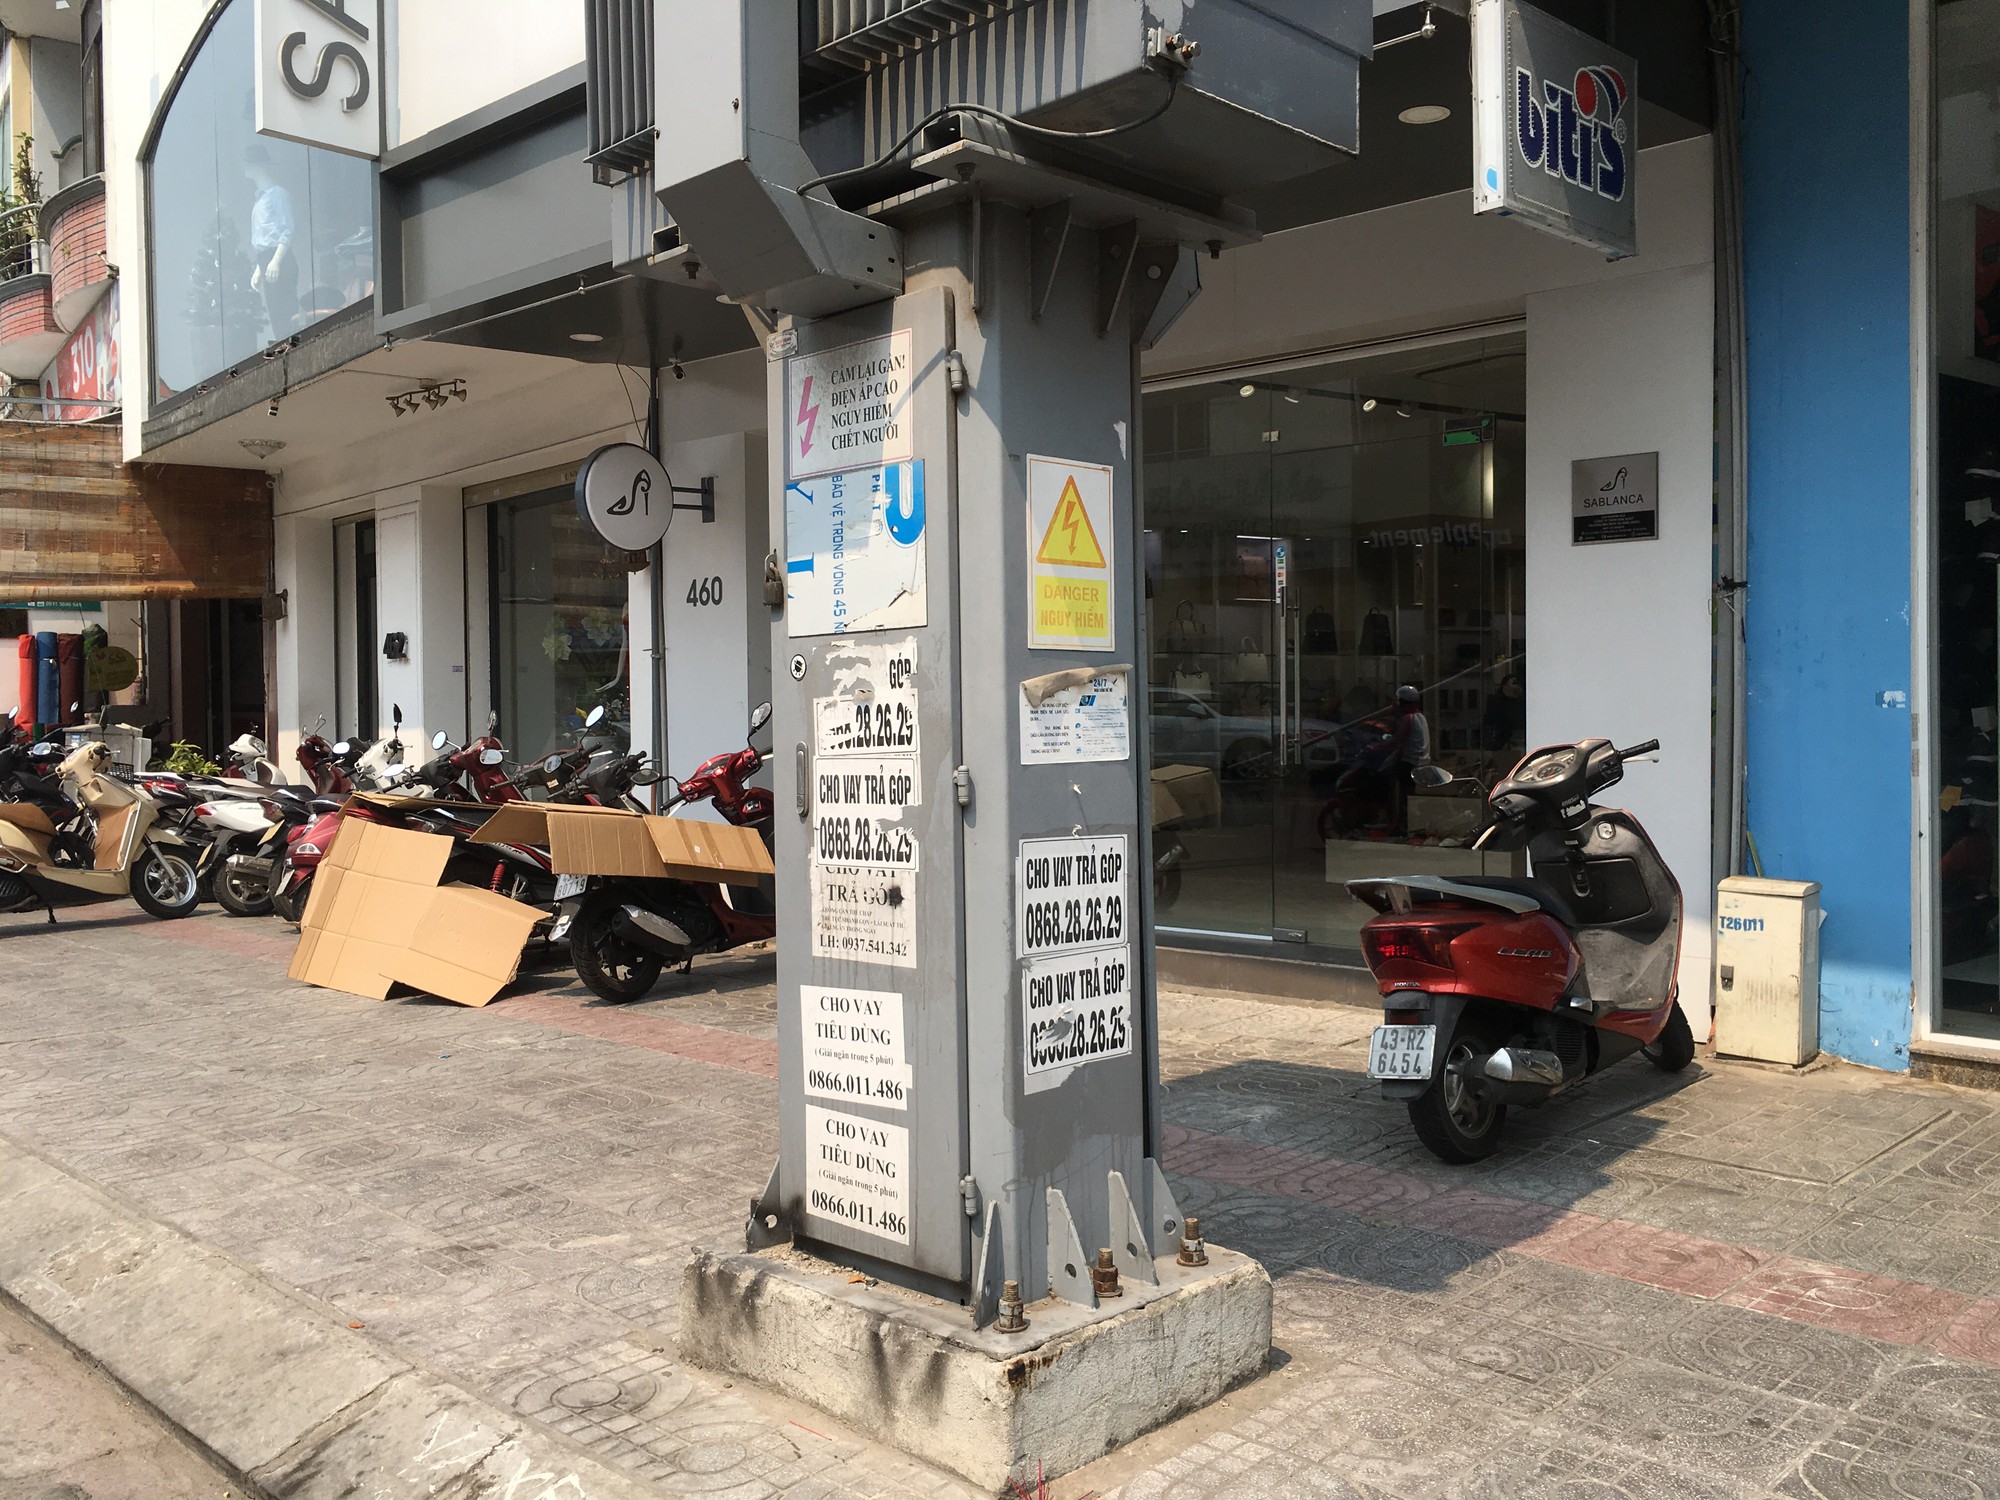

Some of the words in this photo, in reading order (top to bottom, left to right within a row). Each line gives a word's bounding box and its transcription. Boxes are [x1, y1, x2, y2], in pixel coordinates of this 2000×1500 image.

[71, 325, 94, 393] 310
[857, 361, 876, 381] LẠI
[831, 387, 857, 408] ĐIỆN
[859, 382, 873, 402] ÁP
[874, 379, 898, 398] CAO
[831, 409, 861, 429] NGUY
[863, 401, 892, 422] HIỂM
[831, 428, 860, 450] CHẾT
[862, 421, 898, 445] NGƯỜI
[830, 502, 845, 518] VỆ
[1583, 494, 1644, 508] SABLANCA
[832, 521, 844, 560] TRONG
[686, 575, 723, 607] 460
[833, 563, 846, 596] VÒNG
[1043, 584, 1099, 603] DANGER
[833, 599, 846, 617] 45
[1040, 609, 1072, 628] NGUY
[819, 774, 840, 804] CHO
[843, 774, 863, 804] VAY
[864, 764, 886, 805] TRẢ
[889, 768, 911, 806] GÓP
[1026, 857, 1050, 890] CHO
[1053, 856, 1073, 887] VAY
[1075, 844, 1097, 885] TRẢ
[1100, 847, 1122, 884] GÓP
[827, 881, 858, 904] TRẢ
[1025, 895, 1122, 948] 0868.28.26.29
[820, 934, 839, 948] LH:
[1030, 975, 1053, 1009] CHO
[1056, 970, 1076, 1004] VAY
[1079, 957, 1101, 999] TRẢ
[1103, 957, 1125, 995] GÓP
[820, 995, 850, 1013] CHO
[853, 998, 883, 1017] VAY
[815, 1020, 847, 1040] TIÊU
[851, 1022, 891, 1046] DÙNG
[1380, 1028, 1425, 1050] 43-R2
[850, 1051, 869, 1064] trong
[869, 1054, 874, 1062] 5
[1377, 1052, 1421, 1074] 6454
[809, 1068, 903, 1101] 0866.011.486
[826, 1118, 856, 1140] CHO
[860, 1126, 889, 1148] VAY
[820, 1143, 852, 1167] TIÊU
[856, 1149, 896, 1179] DÙNG
[854, 1179, 873, 1194] trong
[874, 1184, 879, 1192] 5
[811, 1188, 907, 1236] 0866.011.486
